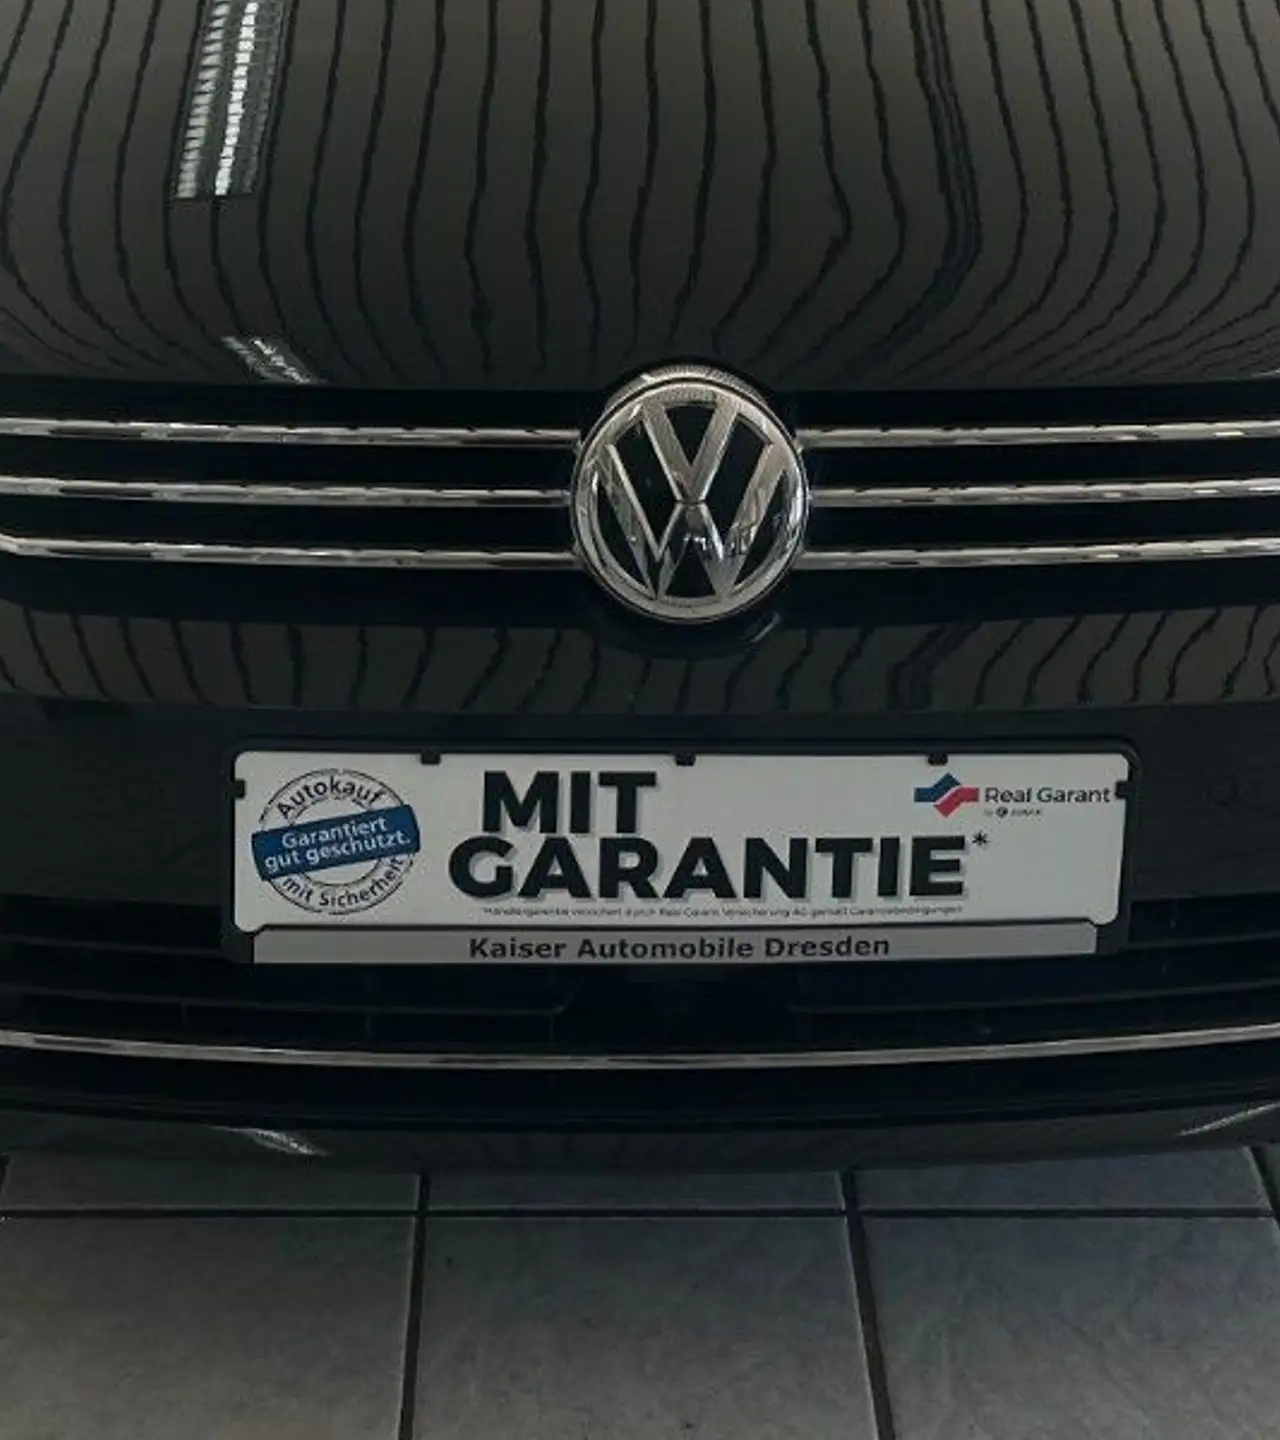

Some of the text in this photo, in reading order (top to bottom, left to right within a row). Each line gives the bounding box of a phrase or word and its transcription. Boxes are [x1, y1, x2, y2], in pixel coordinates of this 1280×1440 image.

[586, 382, 797, 608] VW
[276, 775, 387, 820] Autokauf
[482, 770, 657, 834] MIT
[984, 787, 1111, 804] Real Garant
[281, 817, 388, 849] Garantiert
[264, 850, 301, 874] gut
[281, 856, 405, 908] mit Sicherheit
[469, 935, 890, 959] Kaiser Automobile Dresden
